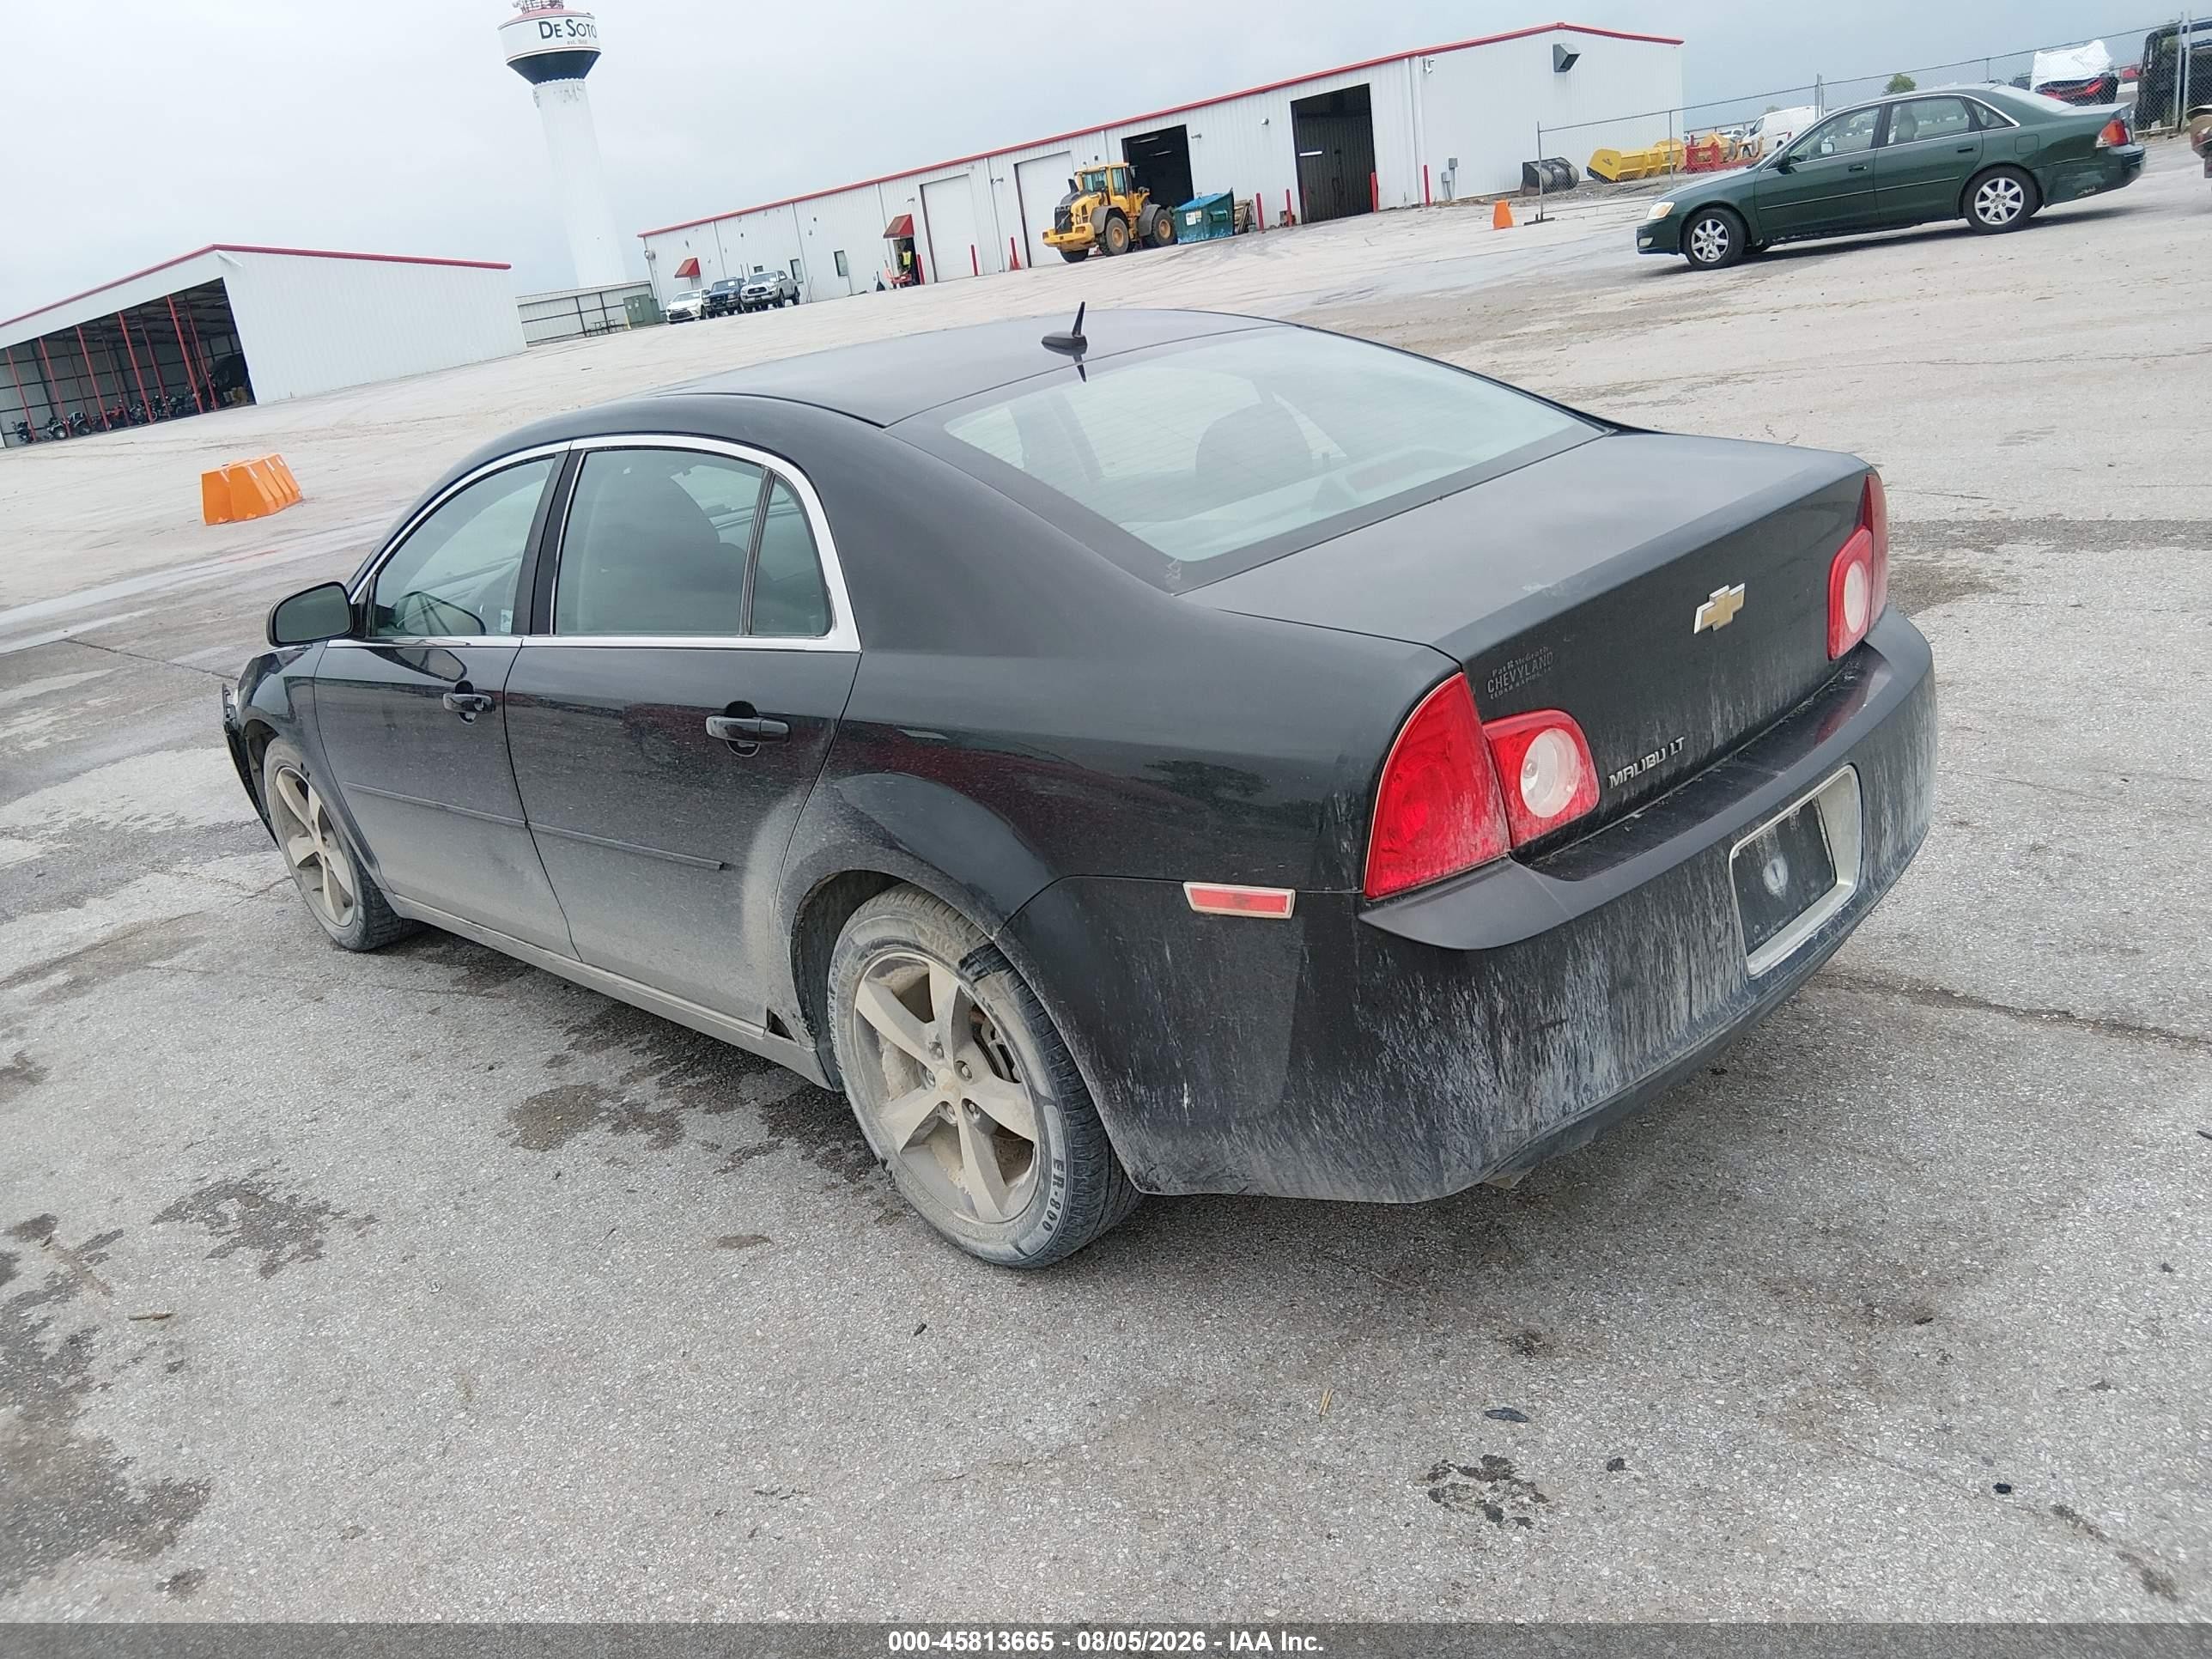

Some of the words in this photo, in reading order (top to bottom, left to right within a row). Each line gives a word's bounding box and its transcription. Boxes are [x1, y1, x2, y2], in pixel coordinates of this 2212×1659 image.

[1487, 652, 1553, 694] CHEVYLAND
[1608, 747, 1667, 789] MALIBU
[1669, 736, 1685, 756] LT
